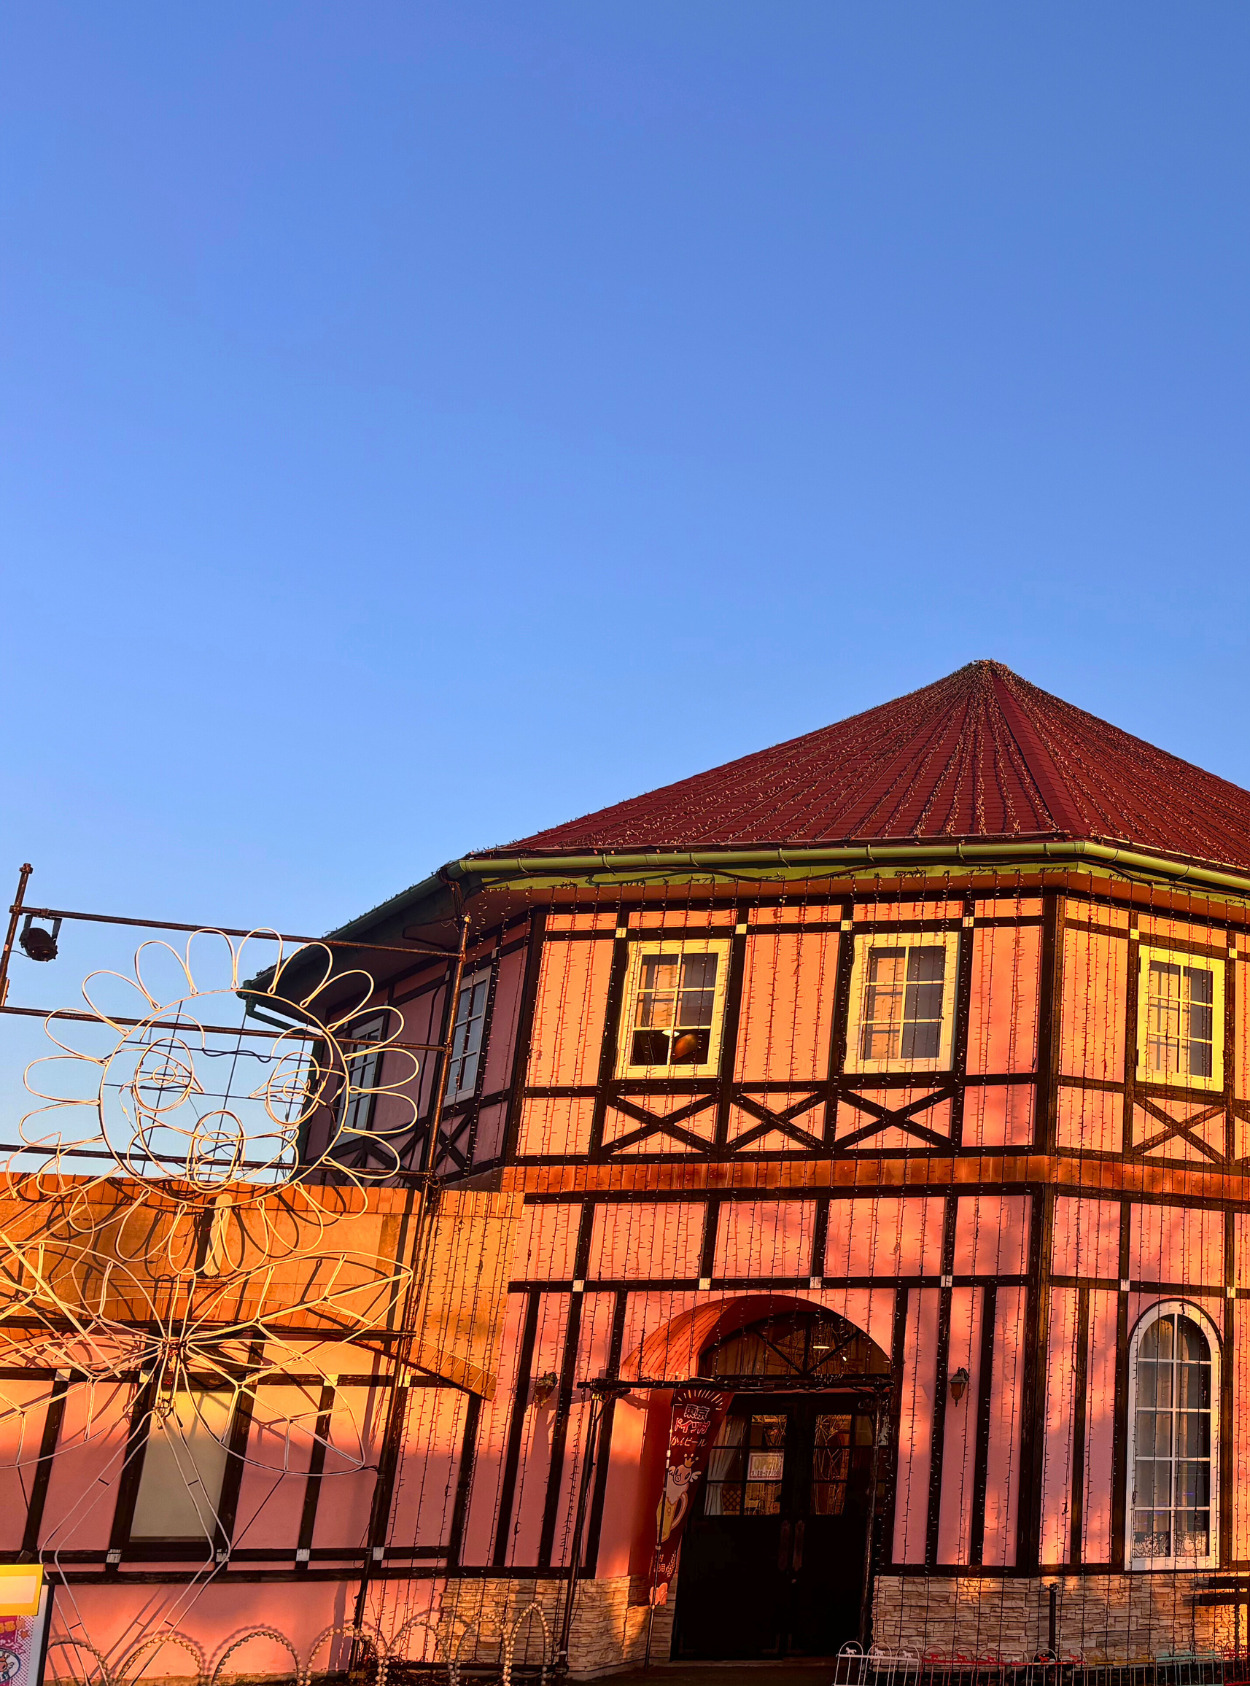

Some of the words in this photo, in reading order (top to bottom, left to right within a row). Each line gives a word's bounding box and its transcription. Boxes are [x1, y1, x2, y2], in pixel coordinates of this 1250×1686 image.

[684, 1404, 710, 1420] 東京
[675, 1418, 711, 1434] ドイツ村
